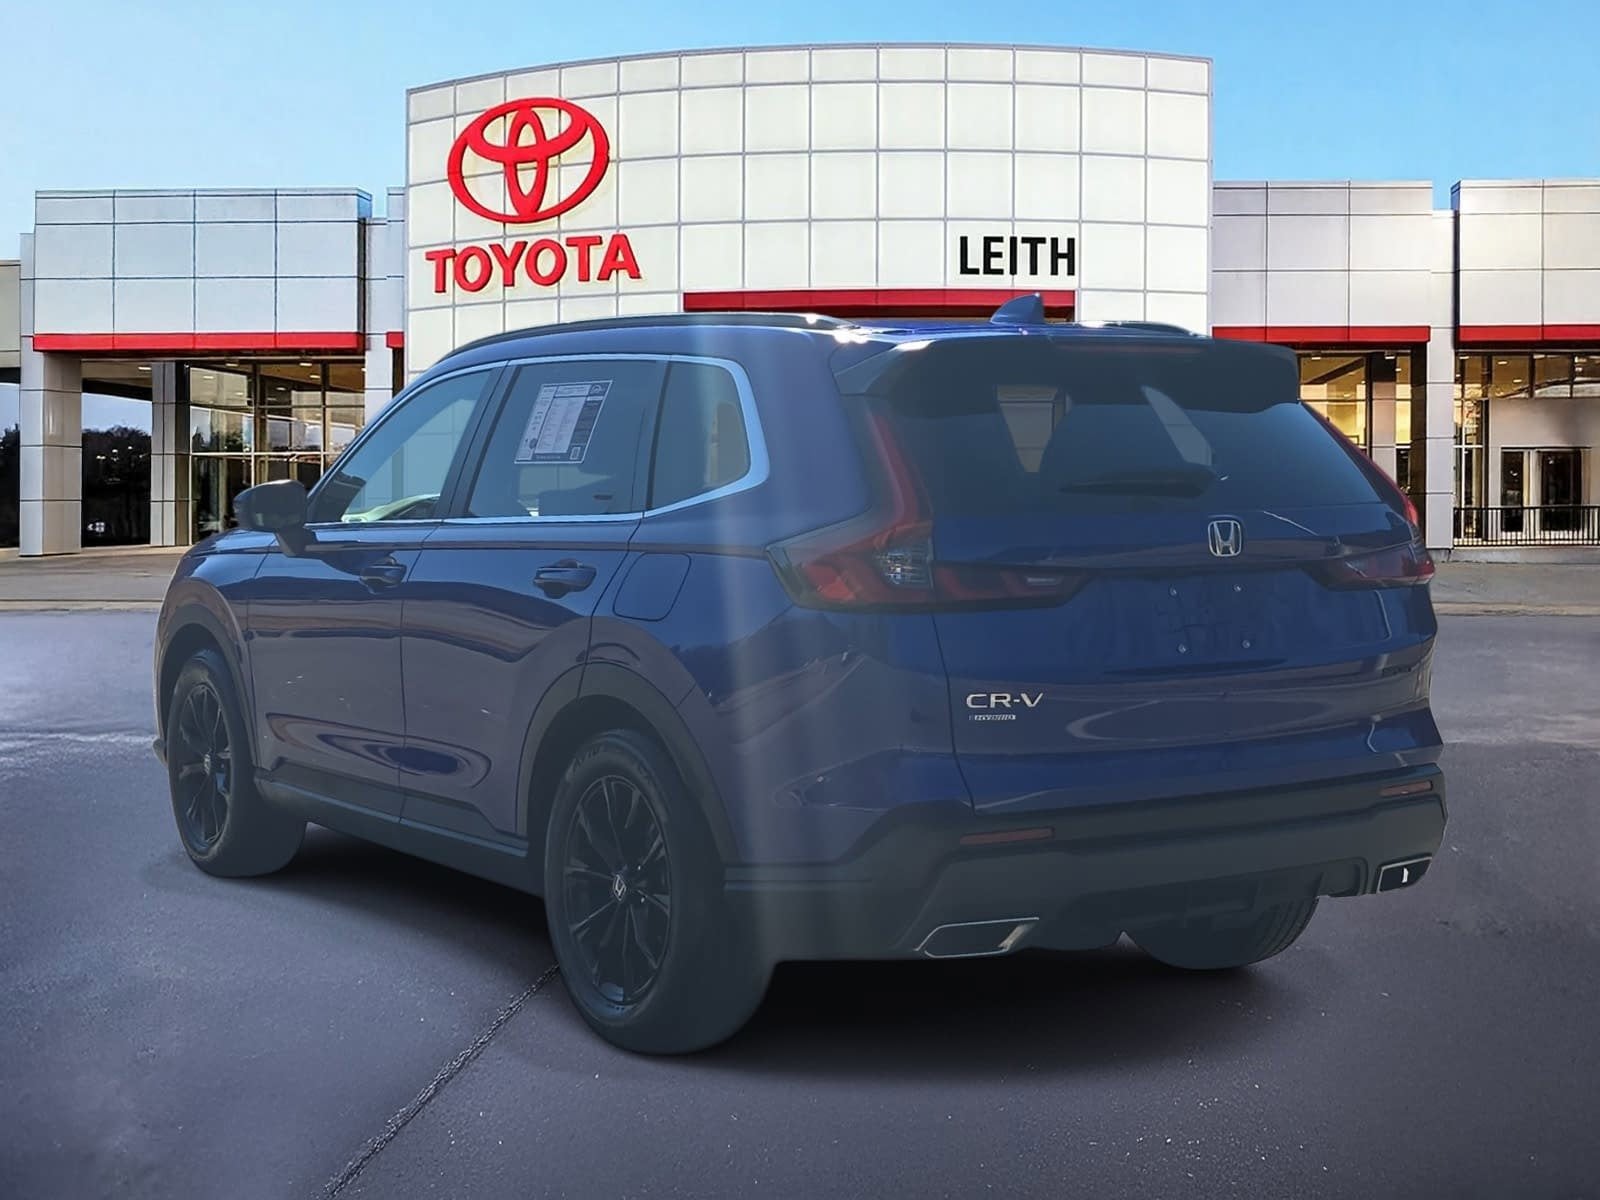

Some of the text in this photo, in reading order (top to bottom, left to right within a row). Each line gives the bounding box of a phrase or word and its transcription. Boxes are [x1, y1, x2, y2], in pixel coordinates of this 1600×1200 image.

[425, 233, 642, 294] TOYOTA
[959, 236, 1076, 276] LEITH
[966, 692, 1044, 709] CR-V
